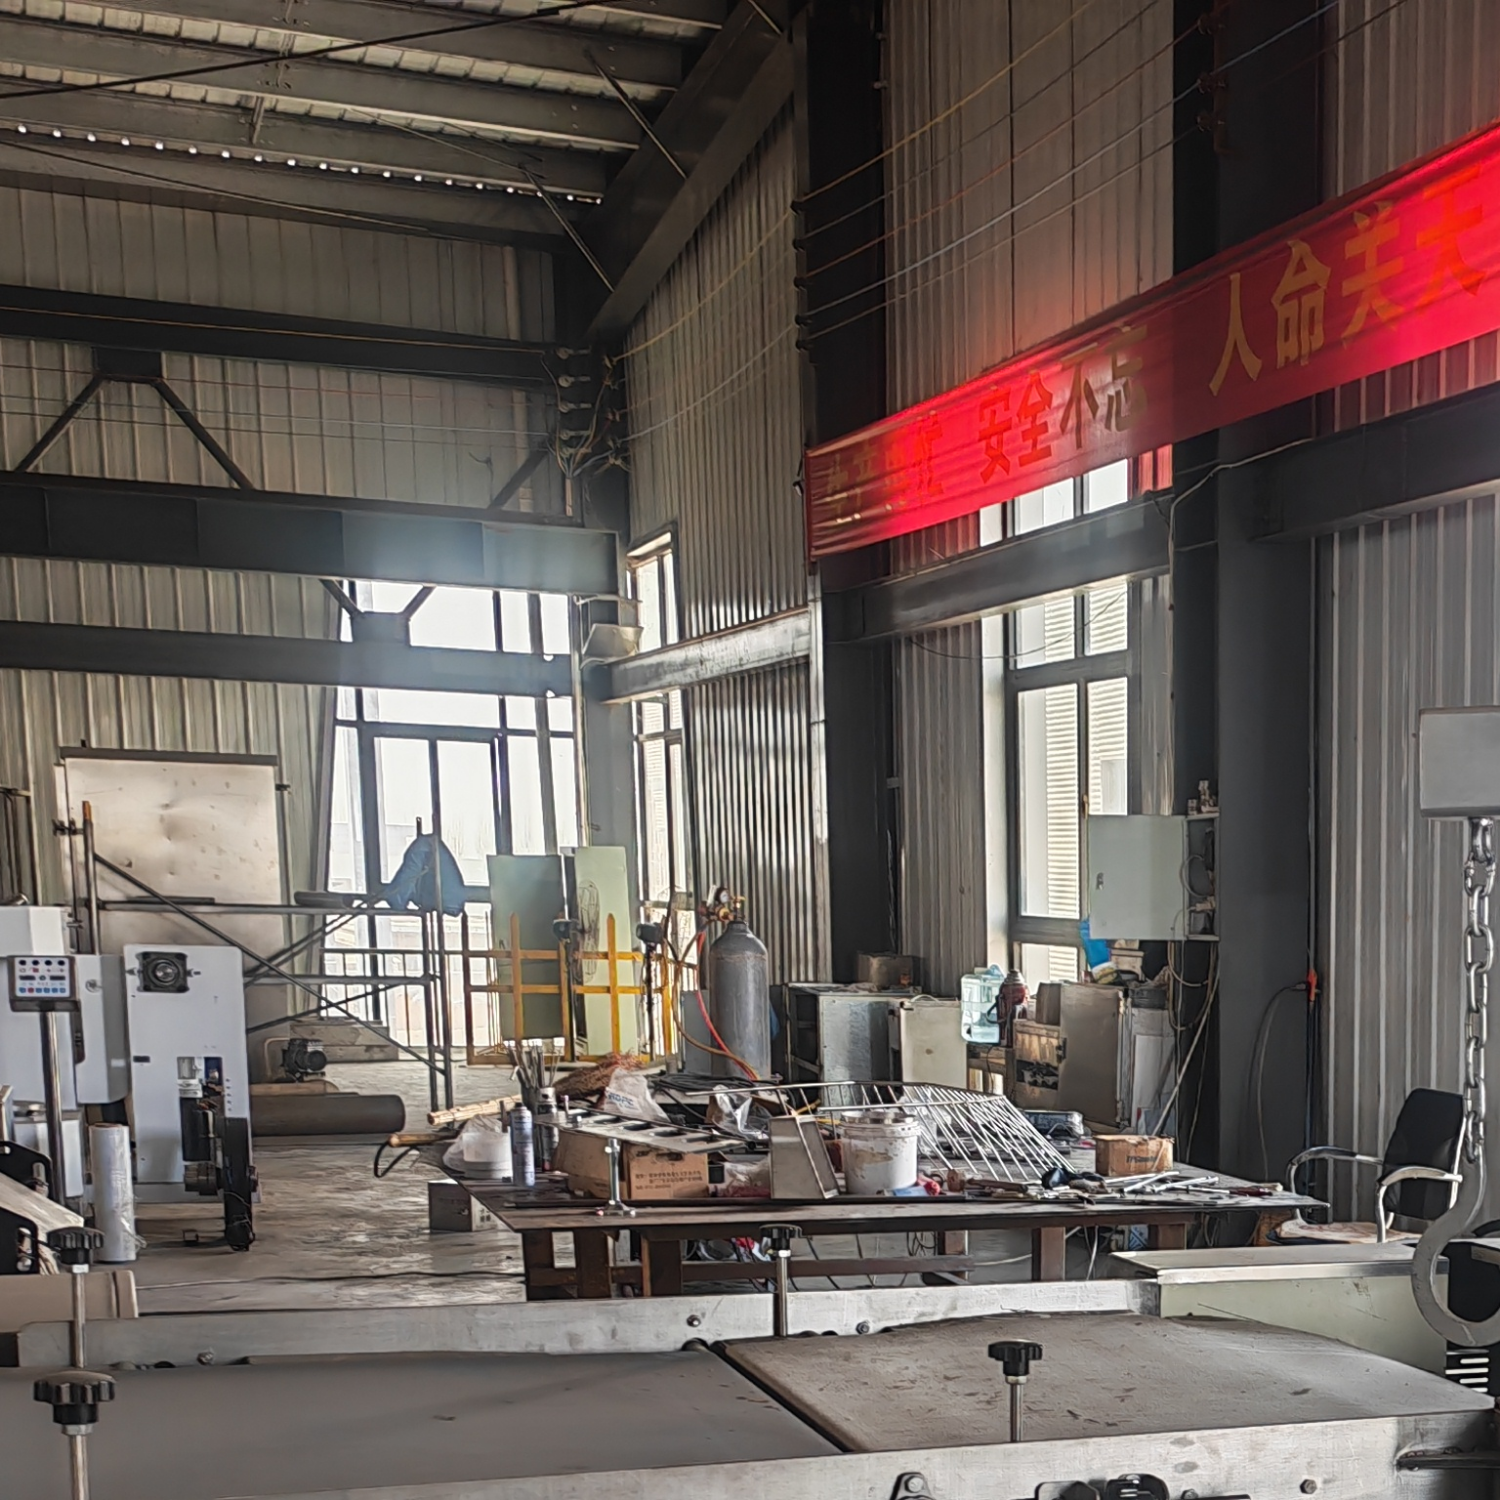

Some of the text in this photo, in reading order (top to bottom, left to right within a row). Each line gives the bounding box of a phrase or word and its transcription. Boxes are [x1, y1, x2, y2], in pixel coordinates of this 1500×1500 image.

[978, 324, 1148, 484] 安全不忘
[1209, 163, 1486, 396] 人命关天
